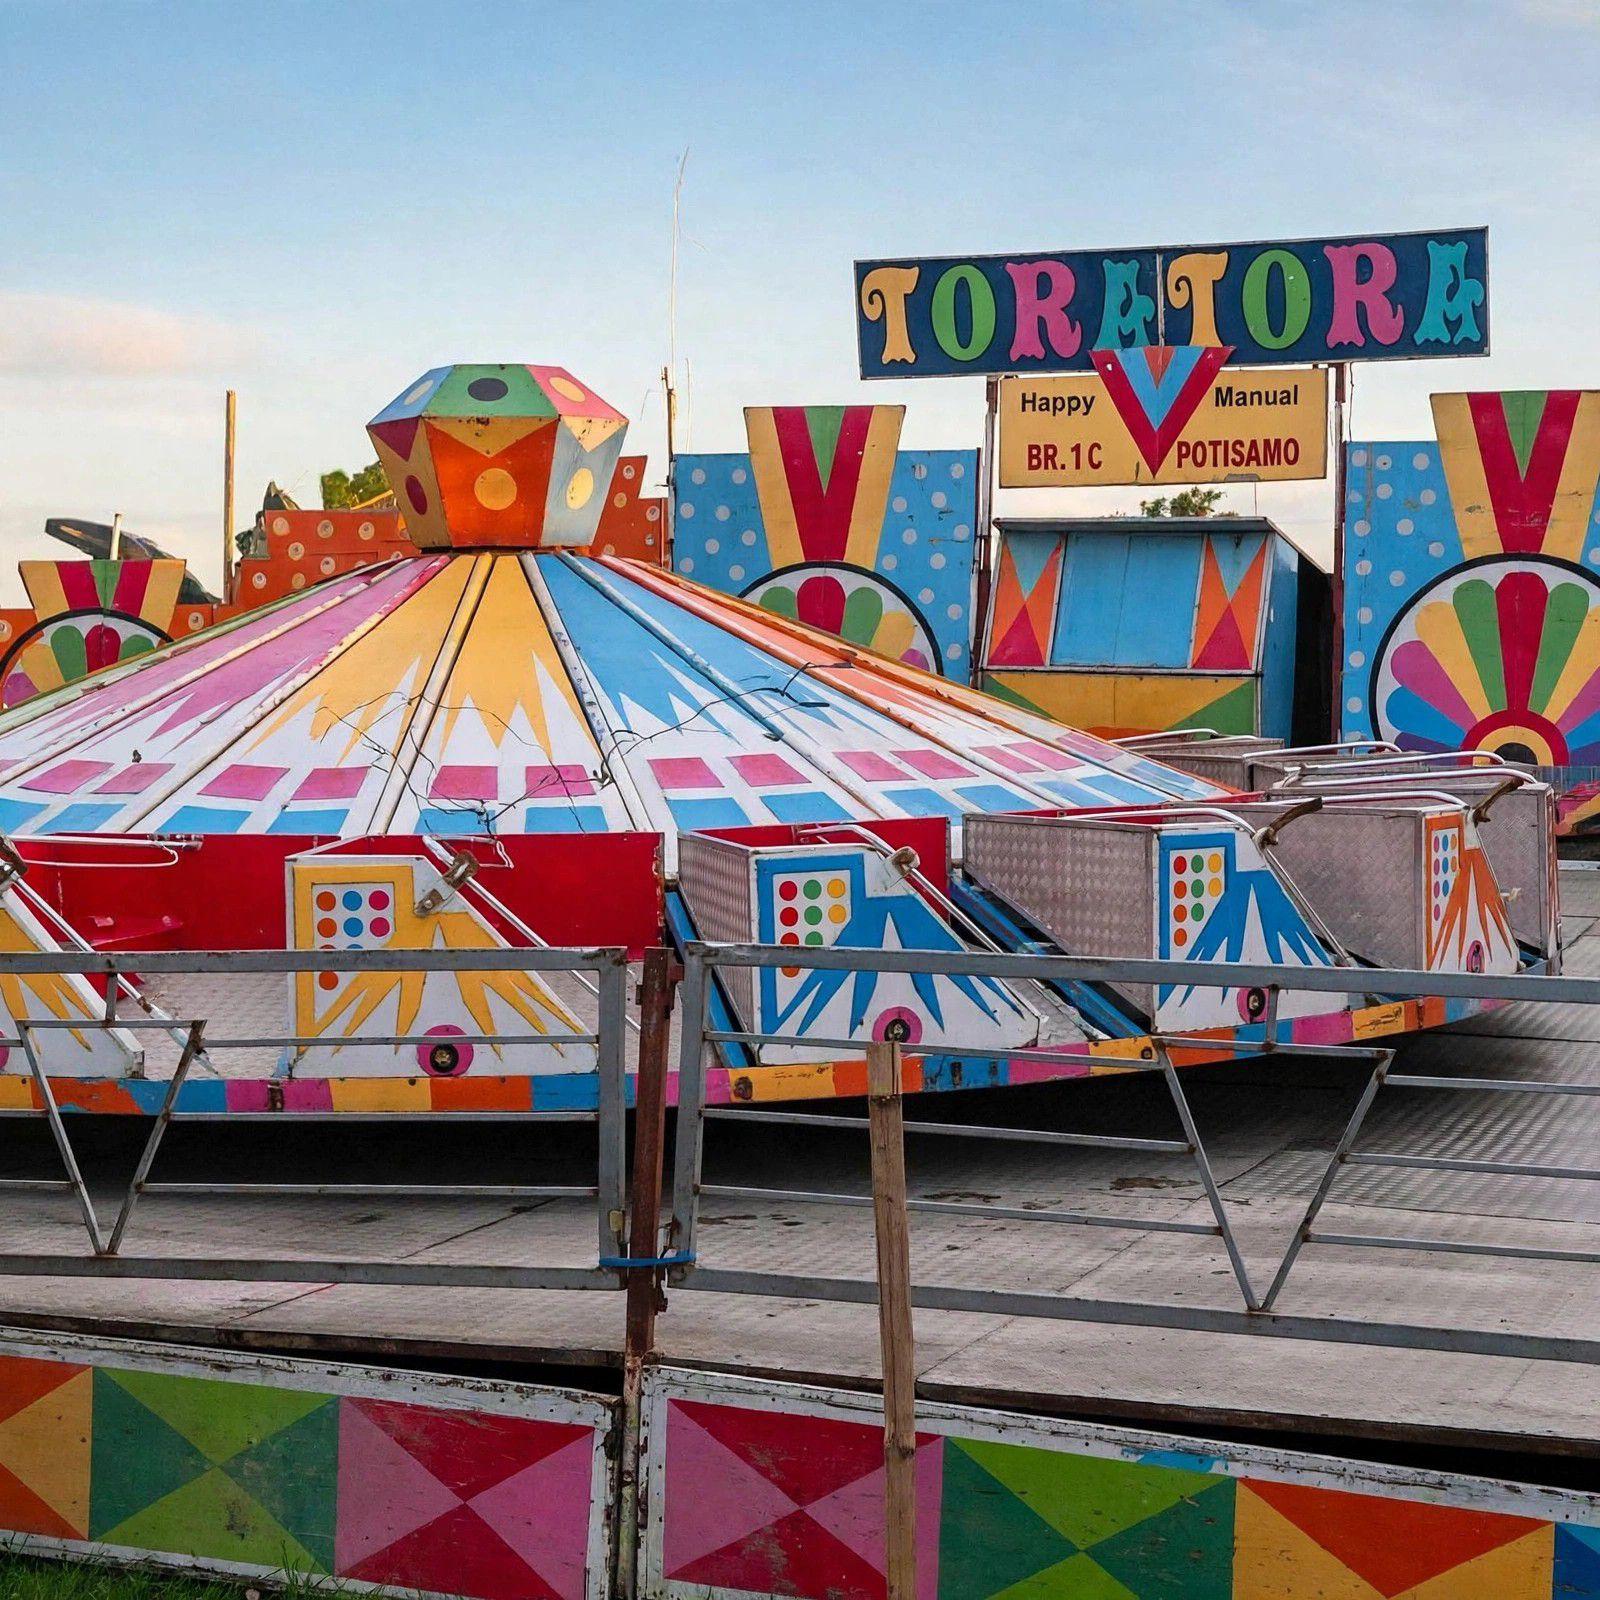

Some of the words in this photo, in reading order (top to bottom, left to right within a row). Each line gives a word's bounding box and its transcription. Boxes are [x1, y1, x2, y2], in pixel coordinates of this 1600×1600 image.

[862, 259, 1156, 364] TORA
[1166, 240, 1485, 348] TORA
[1021, 392, 1095, 416] Happy
[1215, 384, 1298, 407] Manual
[1176, 438, 1299, 468] POTISAMO
